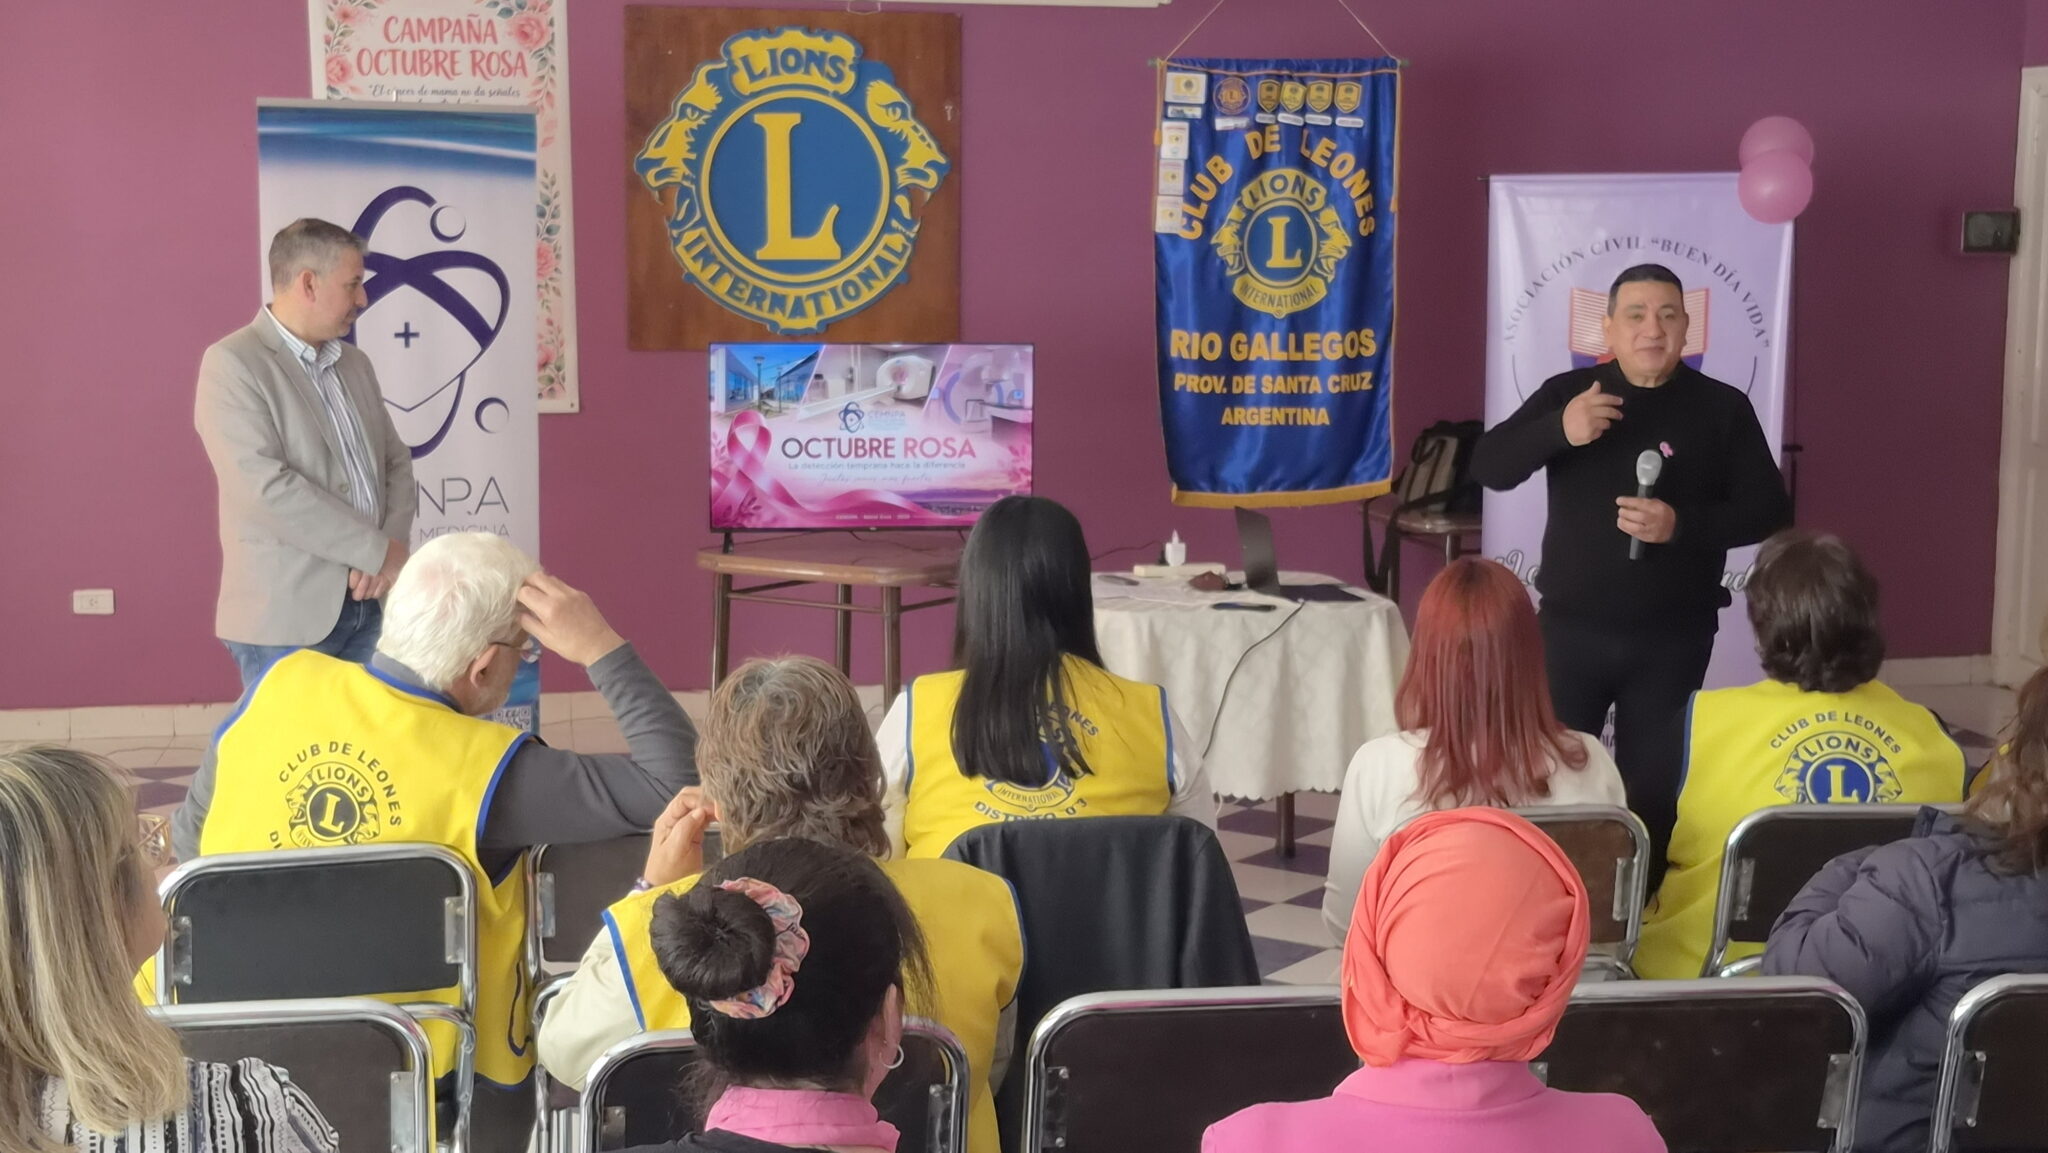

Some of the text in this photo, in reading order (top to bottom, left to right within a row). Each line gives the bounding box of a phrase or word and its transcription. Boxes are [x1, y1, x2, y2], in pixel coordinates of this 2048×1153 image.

[383, 14, 498, 44] CAMPAÑA
[356, 48, 528, 81] OCTUBRE ROSA
[741, 46, 848, 84] LIONS
[417, 84, 428, 96] de
[474, 85, 485, 96] da
[753, 112, 842, 260] L
[1178, 124, 1375, 240] CLUB DE LEONES
[1247, 173, 1321, 207] LIONS
[1265, 216, 1302, 268] L
[682, 234, 906, 320] INTERNATIONAL
[1503, 247, 1585, 344] ASOCIACIÓN
[1590, 236, 1646, 256] CIVIL
[1713, 262, 1741, 293] DÍA
[1239, 282, 1321, 310] INTERNATIONAL
[1170, 328, 1377, 361] RIO GALLEGOS
[1174, 372, 1373, 394] PROV. DE SANTA CRUZ
[1221, 407, 1331, 426] ARGENTINA
[781, 437, 977, 459] OCTUBRE ROSA
[788, 463, 799, 471] La
[801, 462, 843, 471] detección
[847, 462, 888, 471] temprana
[913, 461, 921, 470] la
[923, 461, 966, 470] diferencia
[1770, 711, 1902, 754] CLUB DE LEONES
[1802, 736, 1873, 760] LIONS
[279, 741, 401, 826] CLUB DE LEONES
[317, 766, 369, 798] LIONS
[1826, 765, 1859, 803] L
[319, 793, 345, 833] L
